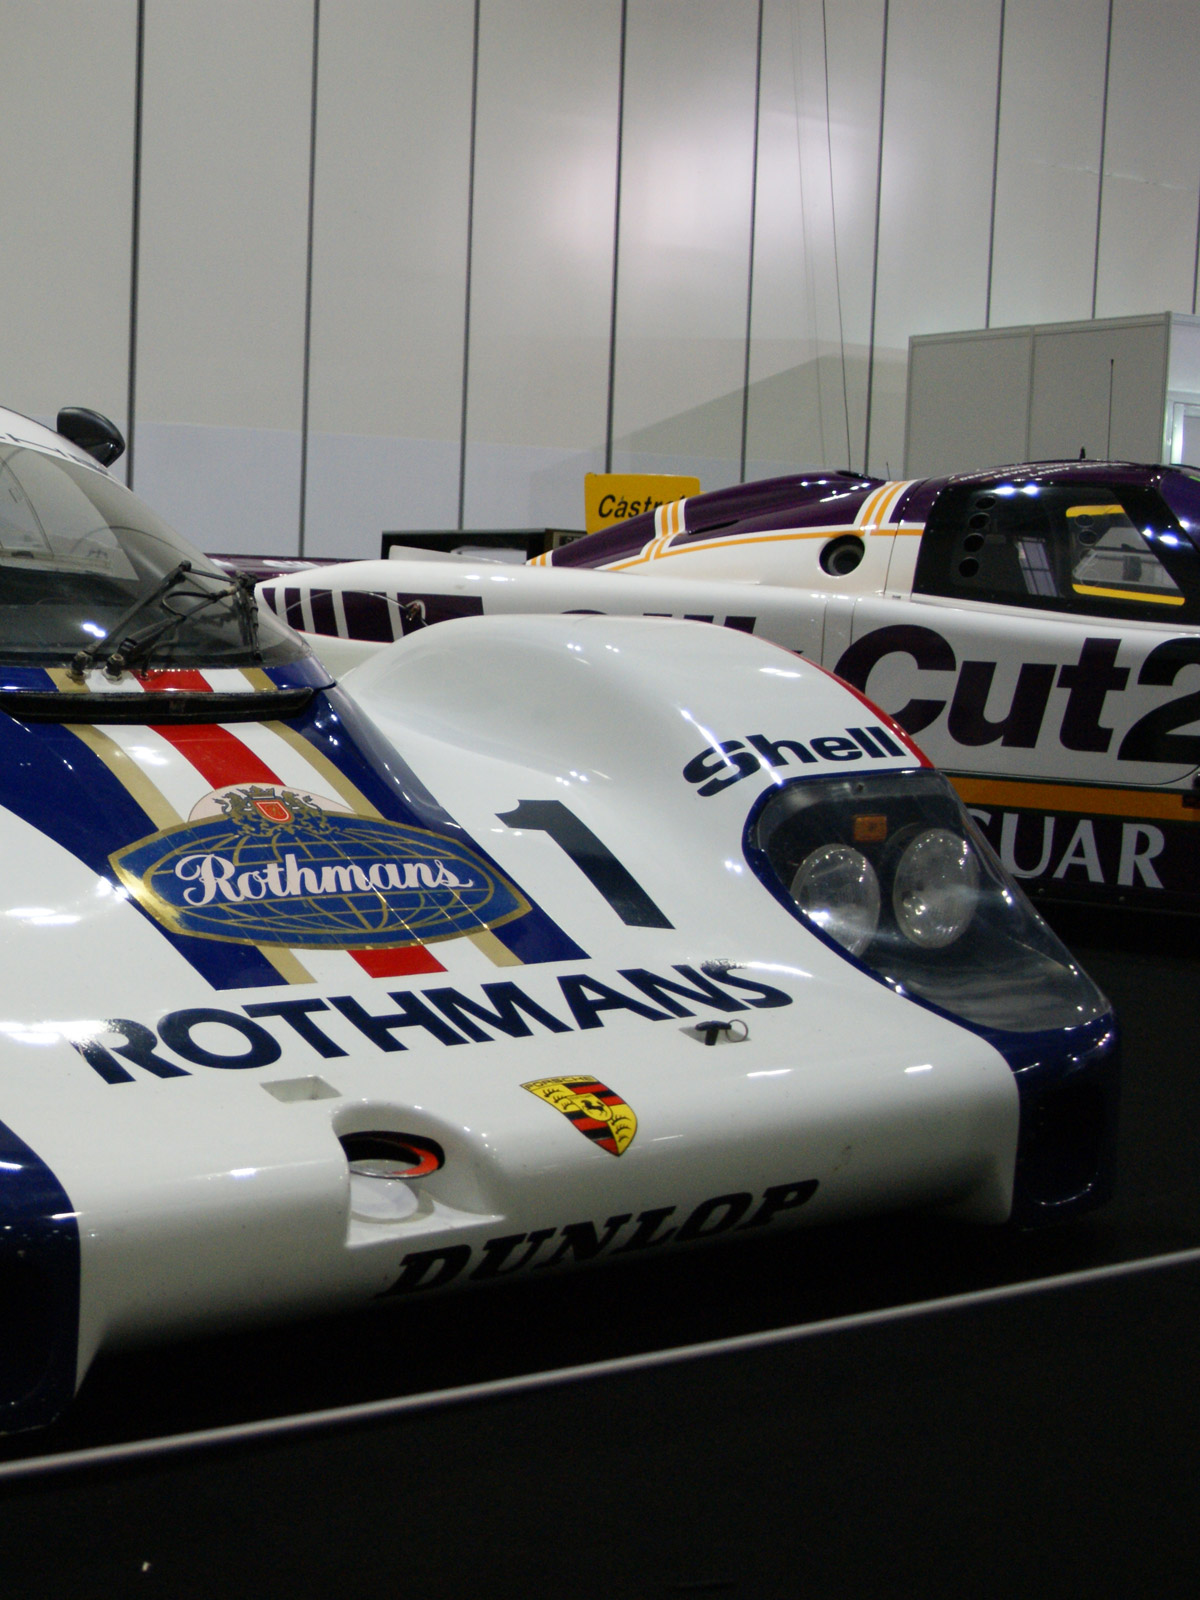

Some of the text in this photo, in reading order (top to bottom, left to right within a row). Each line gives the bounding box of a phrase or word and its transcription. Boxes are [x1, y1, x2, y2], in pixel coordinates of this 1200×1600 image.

[683, 726, 906, 797] Shell
[174, 853, 473, 907] Rothmans
[494, 799, 676, 929] 1
[963, 808, 1166, 890] UAR
[66, 958, 794, 1085] ROTHMANS
[374, 1179, 820, 1299] DUNLOP
